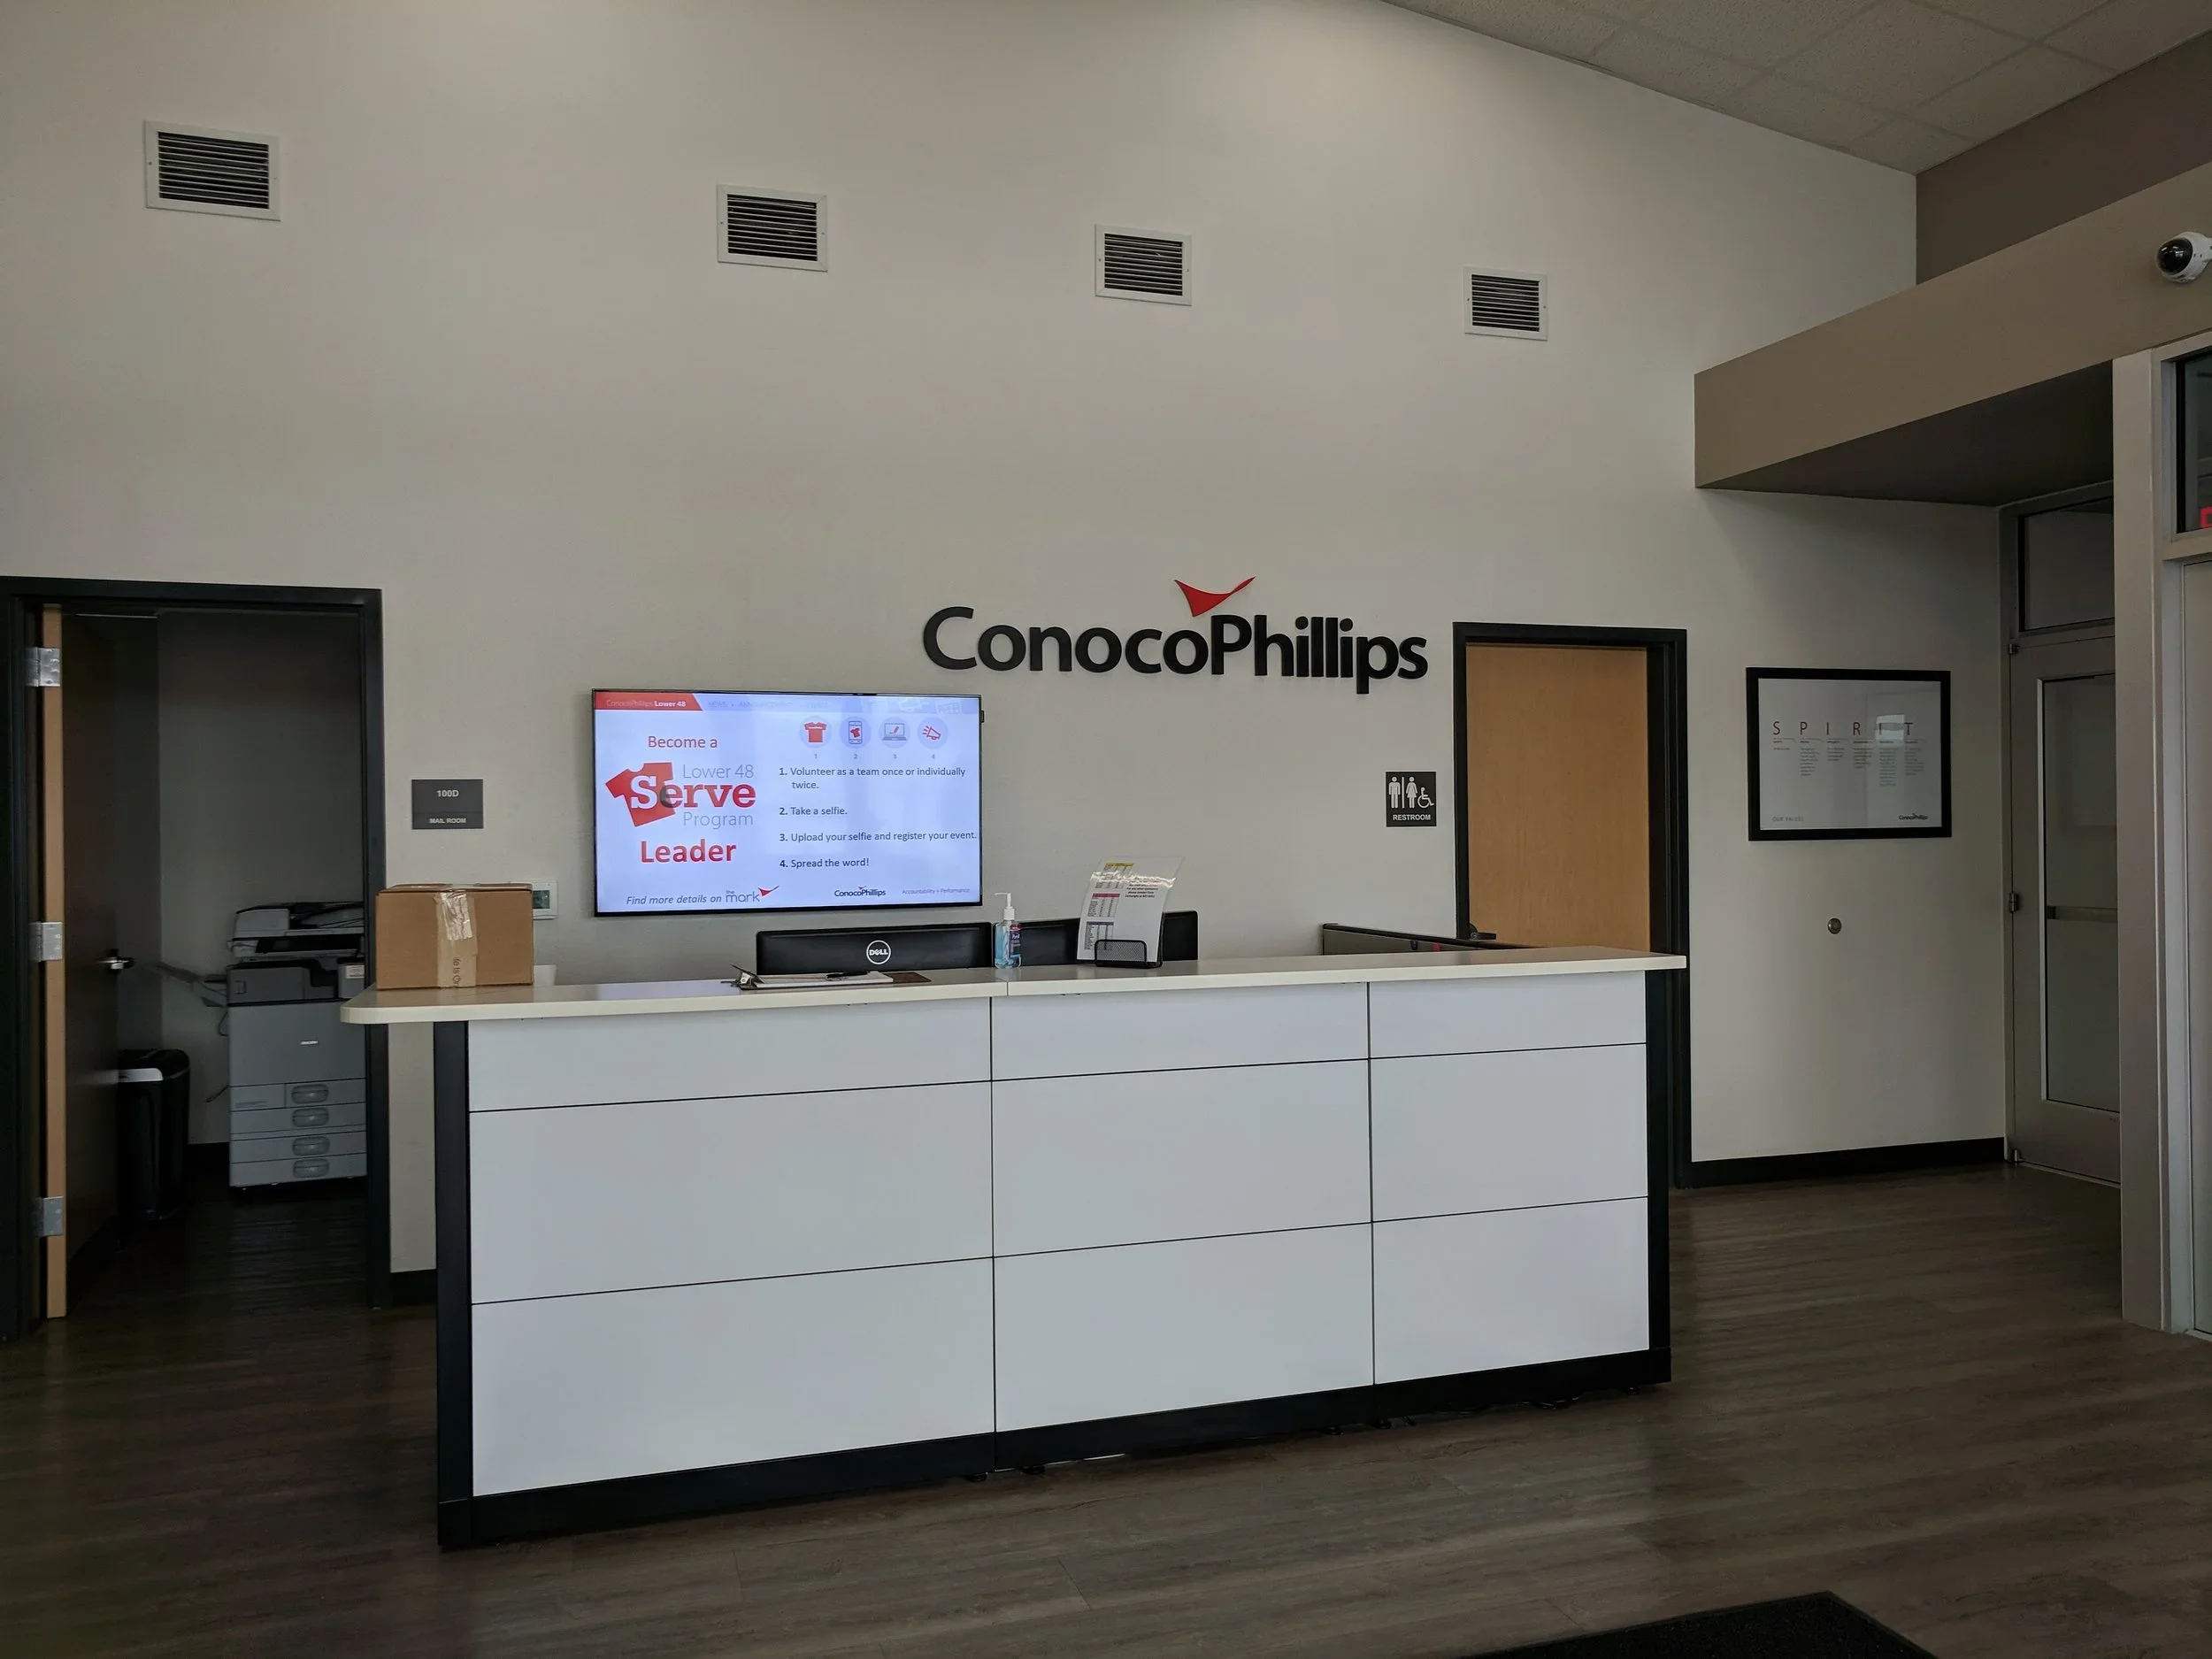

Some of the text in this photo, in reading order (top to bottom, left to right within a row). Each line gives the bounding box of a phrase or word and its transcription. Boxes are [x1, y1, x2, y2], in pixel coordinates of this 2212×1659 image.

[922, 605, 1429, 695] ConocoPhillips
[648, 735, 718, 749] Become a
[683, 764, 754, 779] Lower 48
[791, 767, 835, 776] Volunteer
[917, 767, 966, 778] individually
[792, 780, 819, 789] twice.
[436, 789, 460, 798] 100D
[630, 775, 756, 810] Serve
[791, 807, 811, 816] Take
[821, 806, 848, 816] selfie.
[683, 811, 754, 830] Program
[791, 833, 824, 843] Upload
[826, 833, 846, 843] your
[849, 832, 872, 841] selfie
[874, 832, 891, 841] and
[893, 832, 926, 843] register
[928, 833, 949, 842] your
[641, 838, 737, 864] Leader
[791, 858, 823, 870] Spread
[825, 858, 840, 867] the
[842, 857, 869, 867] word!
[726, 891, 761, 903] mark
[833, 887, 887, 897] ConocoPhillips
[626, 895, 647, 905] Find
[676, 894, 707, 904] details
